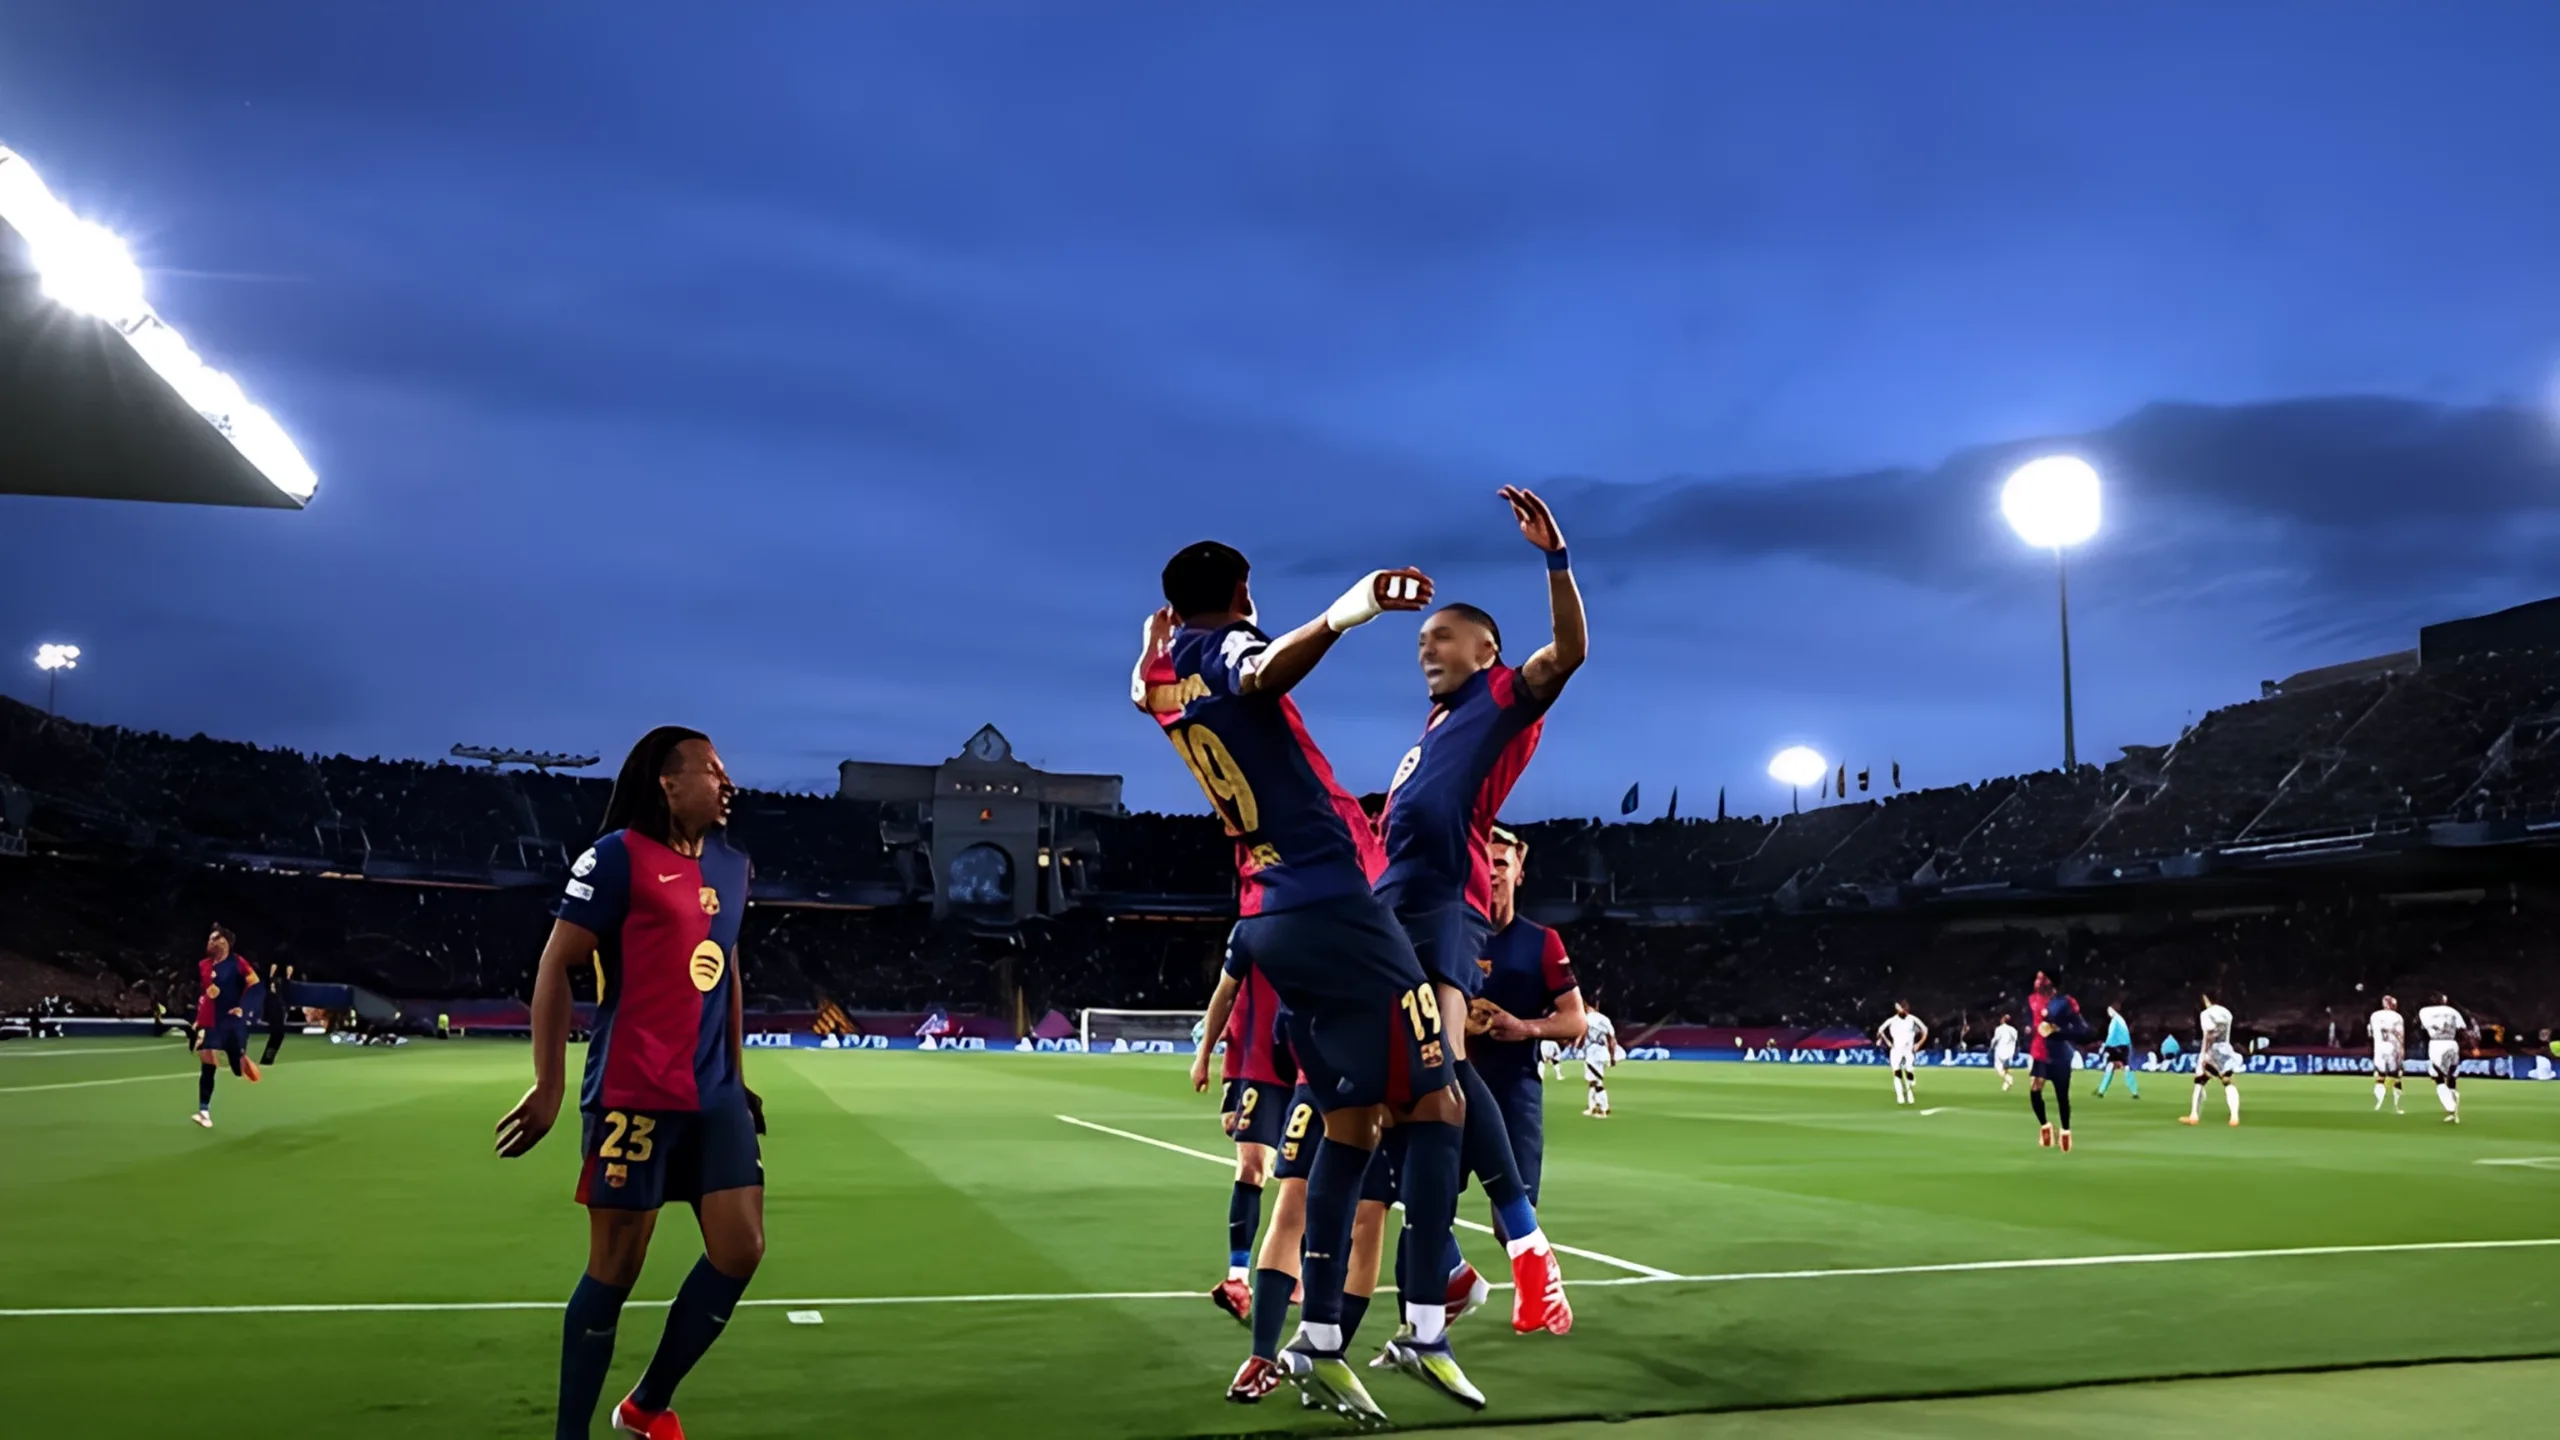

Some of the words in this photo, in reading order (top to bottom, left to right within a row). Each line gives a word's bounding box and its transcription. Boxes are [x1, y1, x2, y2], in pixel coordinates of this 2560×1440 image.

[1401, 982, 1442, 1041] 19
[599, 1110, 656, 1162] 23
[1285, 1103, 1313, 1139] 8
